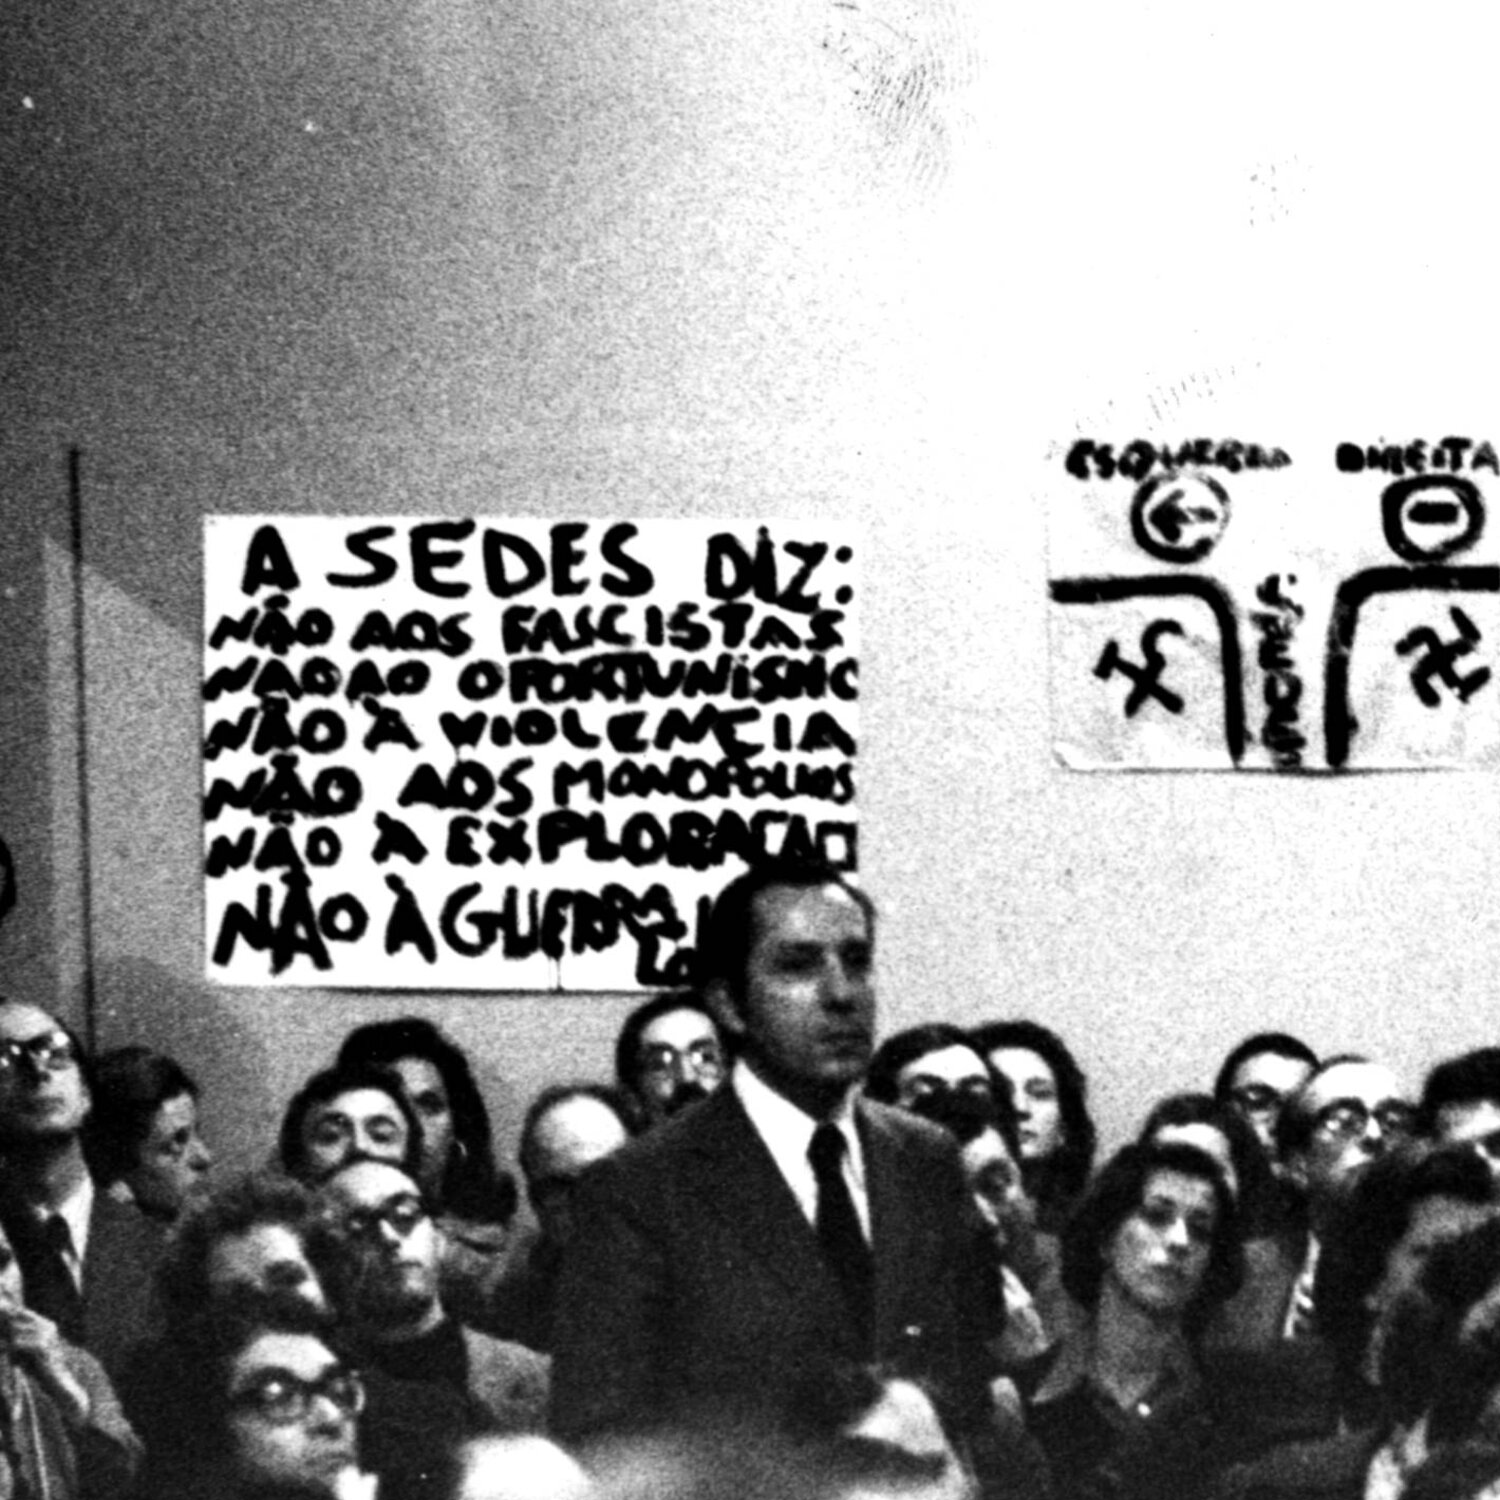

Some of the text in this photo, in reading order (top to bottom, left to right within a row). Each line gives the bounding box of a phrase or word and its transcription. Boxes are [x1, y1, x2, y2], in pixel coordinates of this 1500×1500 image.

[241, 524, 301, 597] A
[325, 518, 655, 599] SEDES
[208, 594, 846, 658] NÃO AOS FASCISTAS
[345, 658, 431, 706] AO
[202, 697, 348, 760] NÃO
[202, 752, 364, 822] NÃO
[396, 757, 534, 820] AOS
[204, 810, 343, 878] NÃO
[212, 868, 369, 978] NÃO
